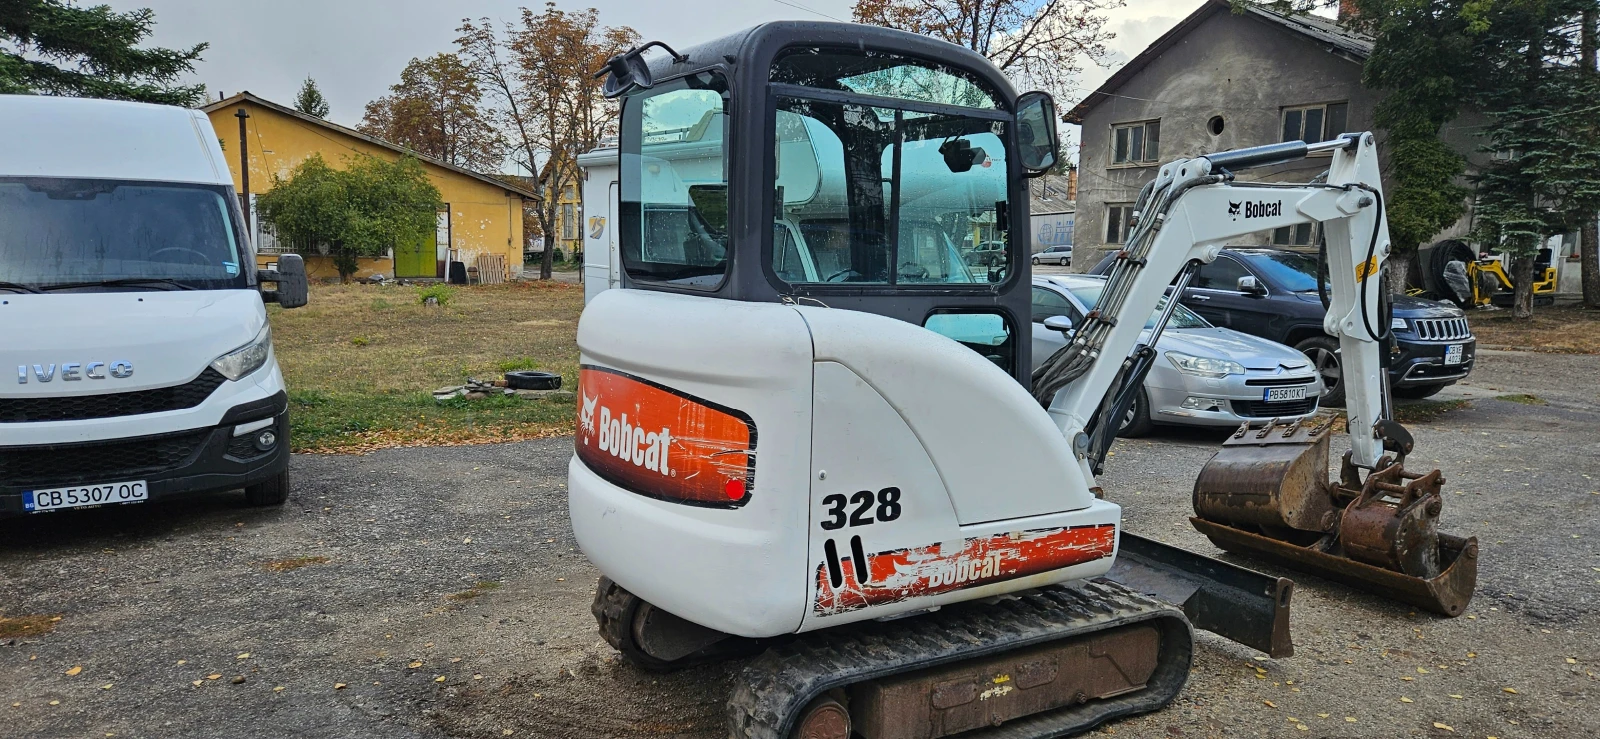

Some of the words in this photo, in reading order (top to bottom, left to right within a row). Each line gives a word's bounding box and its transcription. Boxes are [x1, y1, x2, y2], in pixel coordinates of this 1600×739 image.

[1245, 200, 1282, 219] Bobcat
[17, 359, 134, 384] IVECO
[598, 406, 671, 476] Bobcat
[37, 491, 63, 507] CB
[67, 486, 114, 504] 5307
[118, 483, 144, 499] OC
[820, 486, 902, 531] 328
